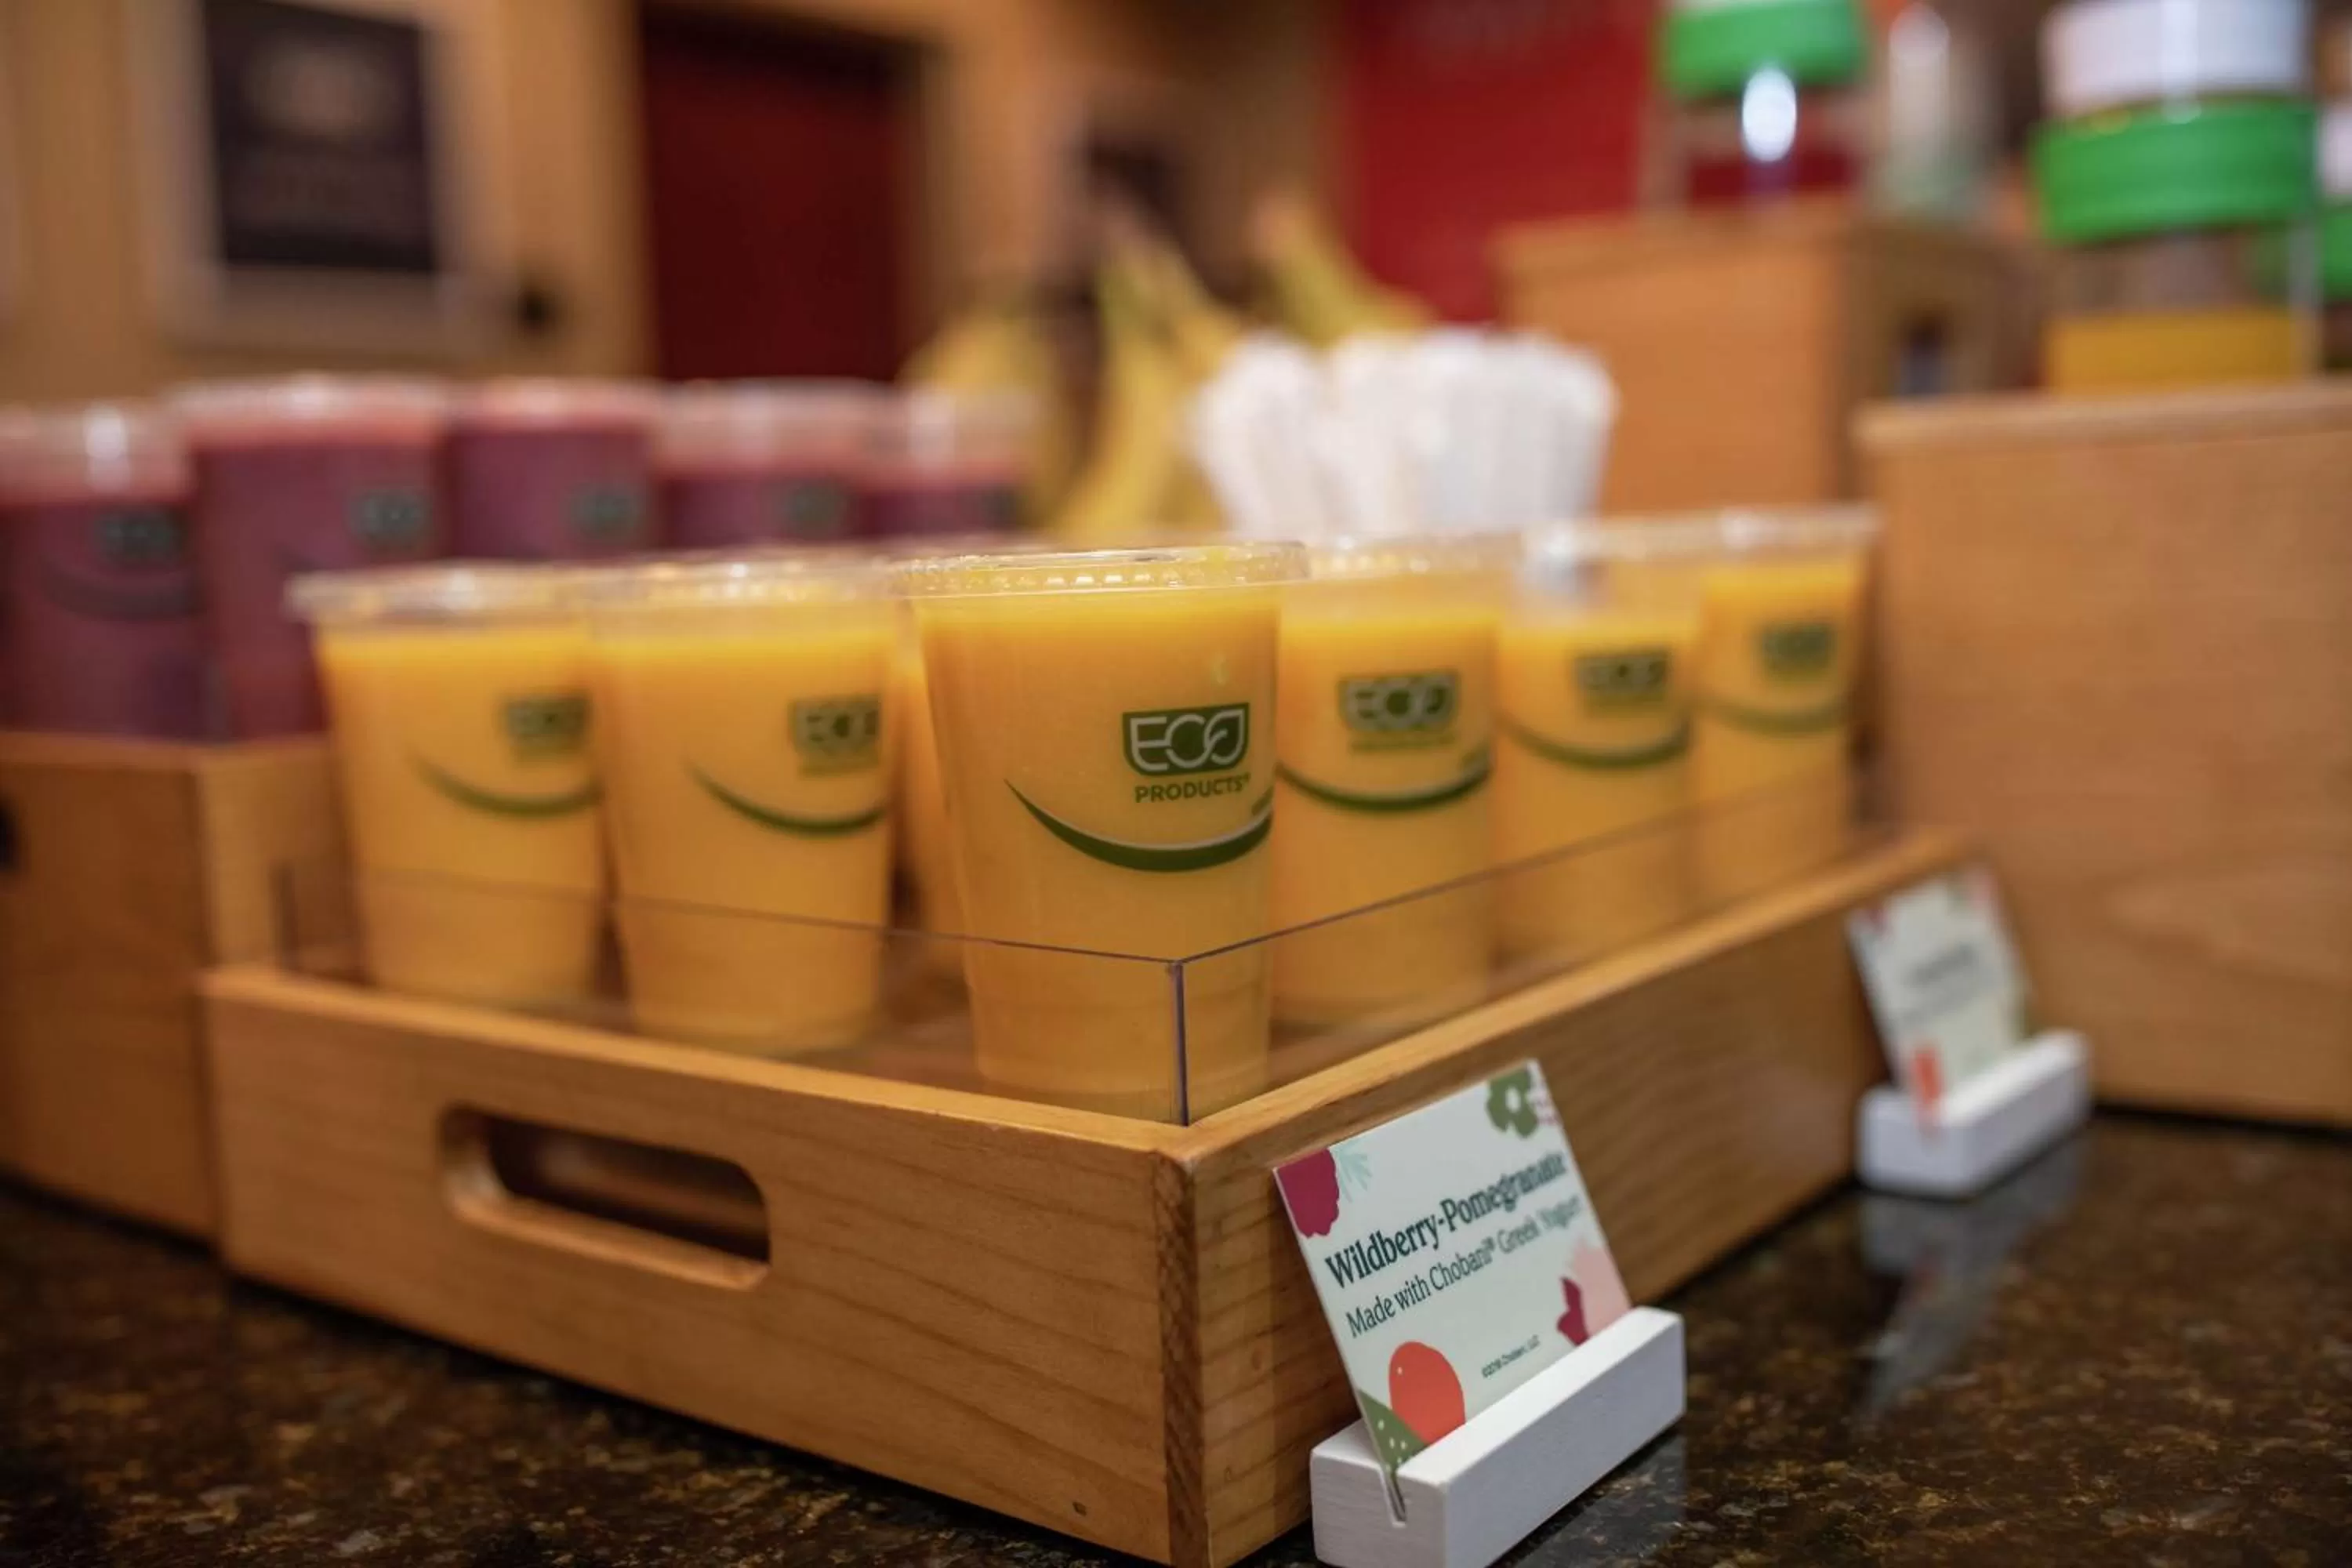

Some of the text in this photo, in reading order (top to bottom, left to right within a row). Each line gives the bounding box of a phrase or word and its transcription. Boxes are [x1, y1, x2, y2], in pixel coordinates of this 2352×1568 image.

[1130, 708, 1246, 771] ECO
[1324, 1152, 1566, 1289] Wildberry-Pomegranate
[1345, 1295, 1396, 1339] Made
[1394, 1274, 1432, 1311] with
